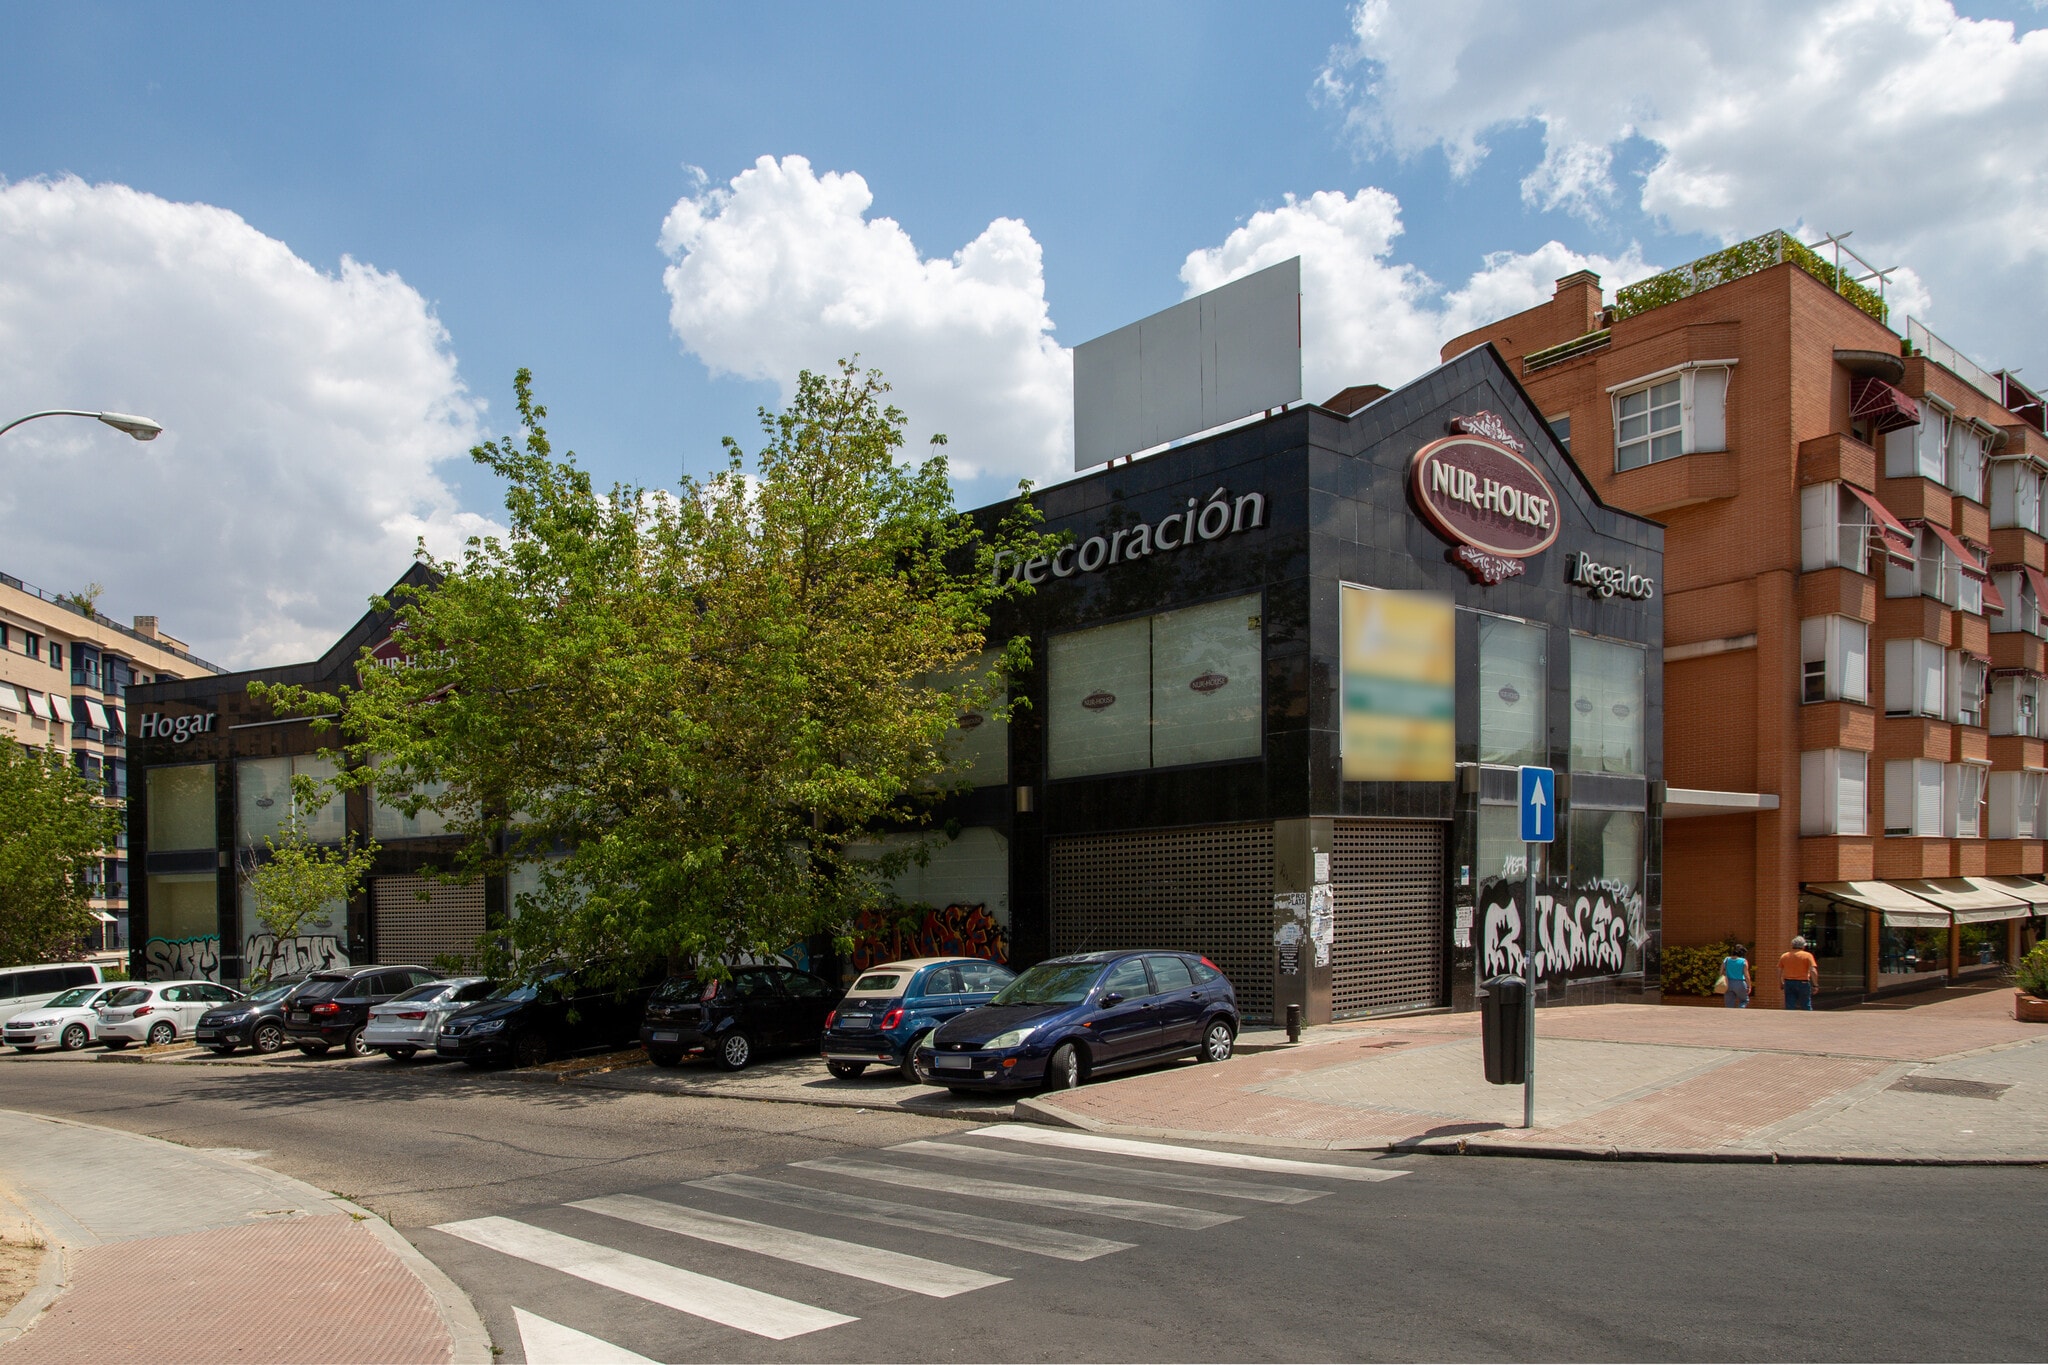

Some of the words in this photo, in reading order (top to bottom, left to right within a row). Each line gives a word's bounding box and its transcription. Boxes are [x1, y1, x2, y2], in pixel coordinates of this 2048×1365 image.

[1432, 459, 1551, 530] NUR-HOUSE
[991, 487, 1266, 590] Decoración
[1574, 551, 1654, 599] Regalos
[140, 712, 216, 743] Hogar
